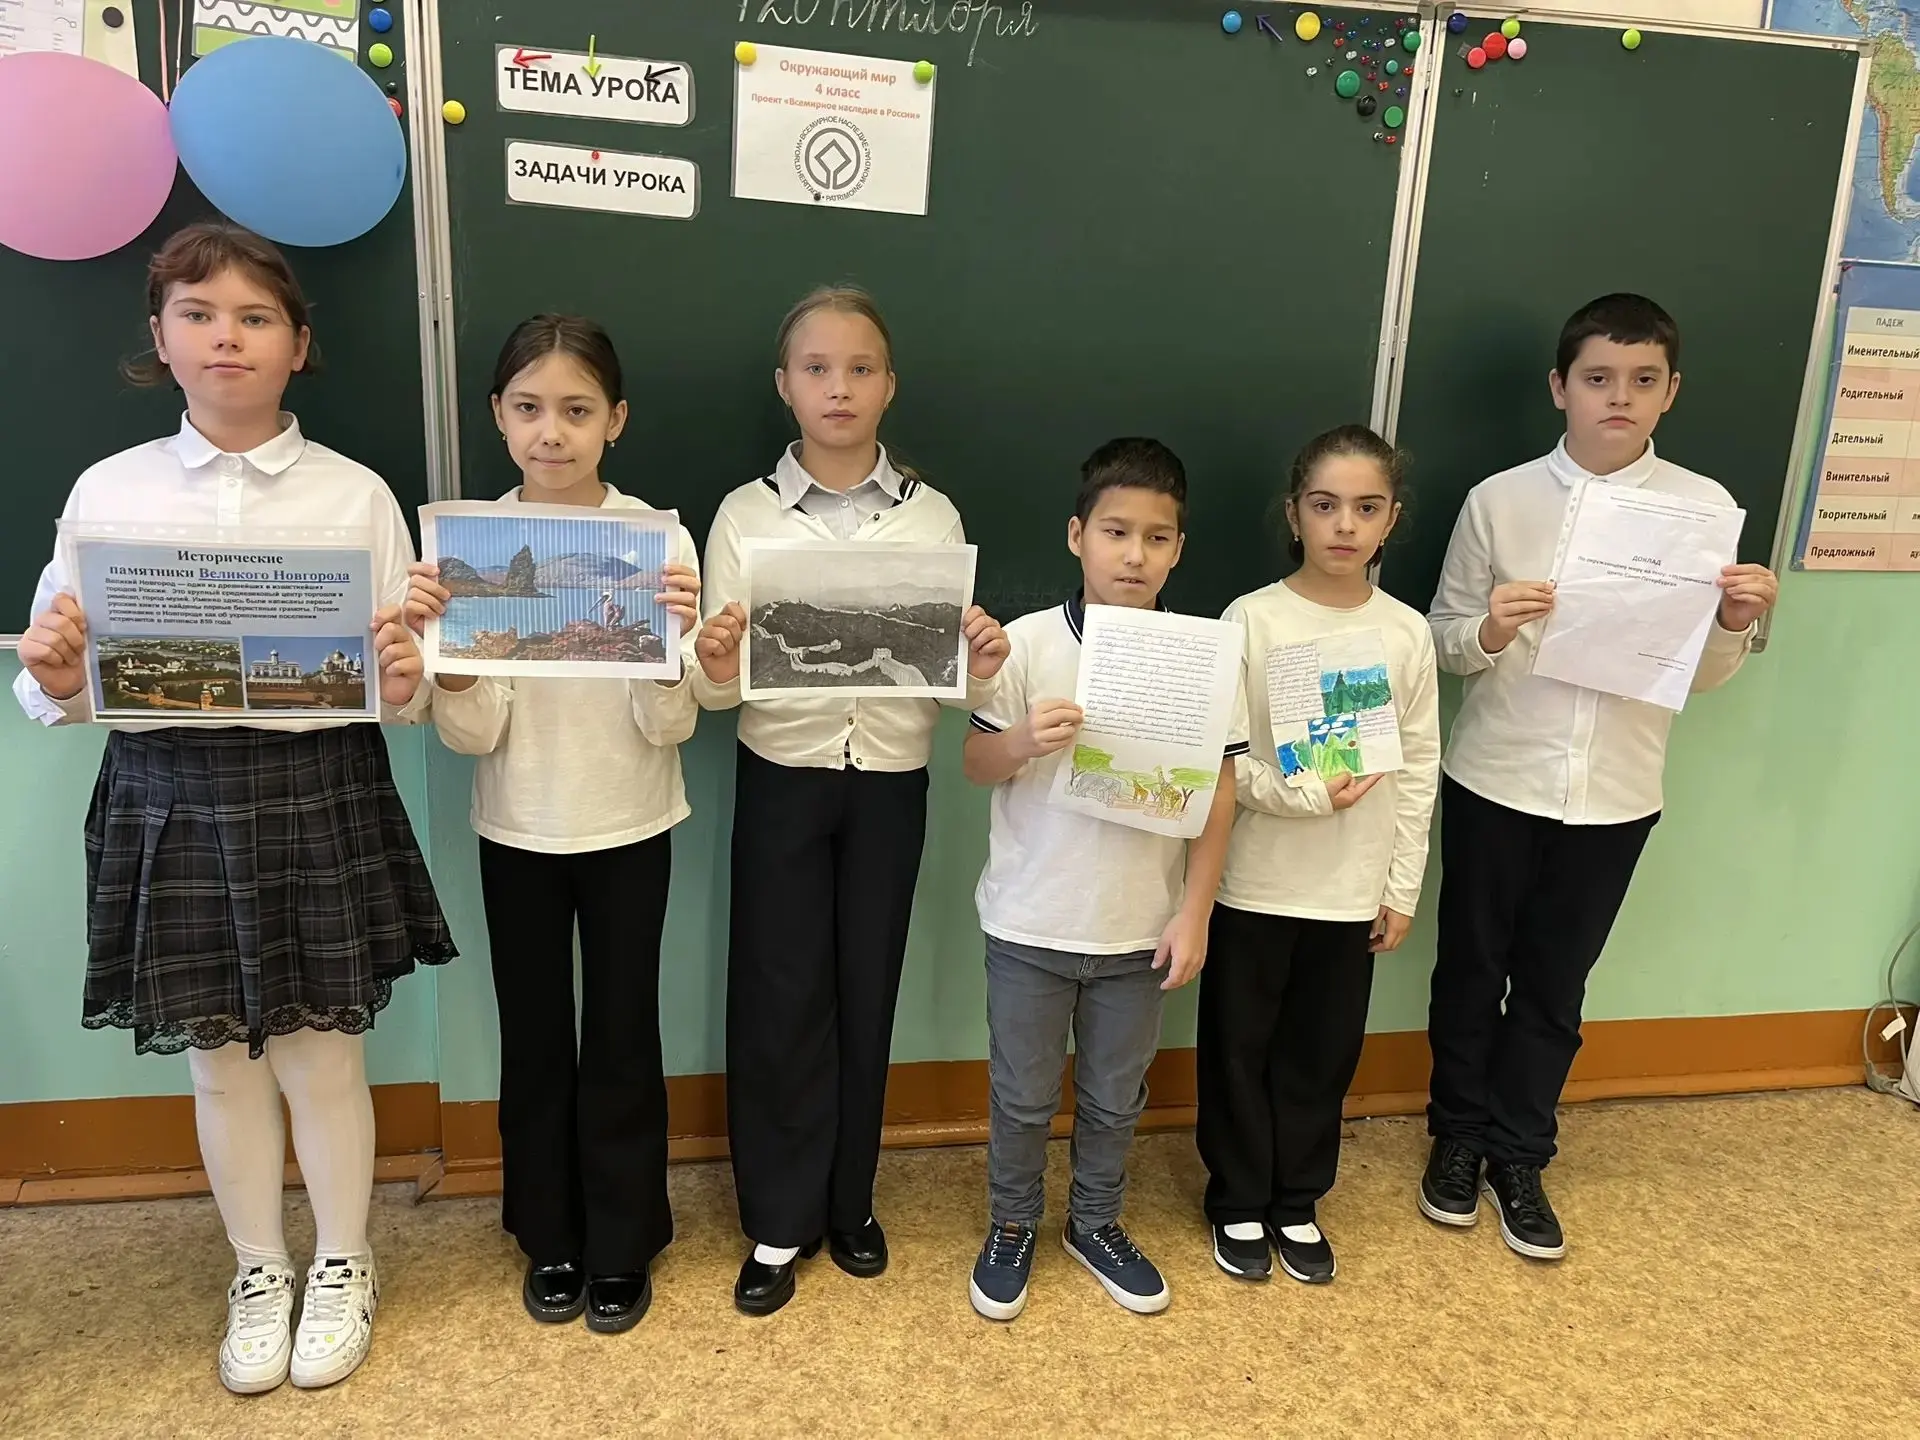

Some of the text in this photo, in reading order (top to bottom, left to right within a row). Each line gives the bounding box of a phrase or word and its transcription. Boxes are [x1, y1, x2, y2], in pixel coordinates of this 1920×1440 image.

[779, 59, 897, 85] Окружающий мир
[504, 66, 681, 105] ТЕМА УРОКА
[815, 83, 861, 99] 4 класс
[751, 93, 921, 120] Проект «Всемирное наследие в России»
[800, 115, 869, 149] ВСЕМИРНОЕ НАСЛЕДИЕ
[794, 141, 803, 171] WORLD
[514, 159, 686, 194] ЗАДАЧИ УРОКА
[825, 147, 872, 201] PATRIMOINE MONDIAL
[1876, 317, 1905, 328] ПАДЕЖ
[1847, 345, 1920, 359] Именительный
[1840, 387, 1904, 400] Родительный
[1832, 433, 1884, 444] Дательный
[1825, 471, 1890, 483] Винительный
[1818, 509, 1887, 521] Творительный
[177, 550, 284, 565] Исторические
[1810, 546, 1876, 559] Предложный
[1632, 555, 1662, 567] ДОКЛАД
[109, 565, 351, 583] памятники Великого Новгорода
